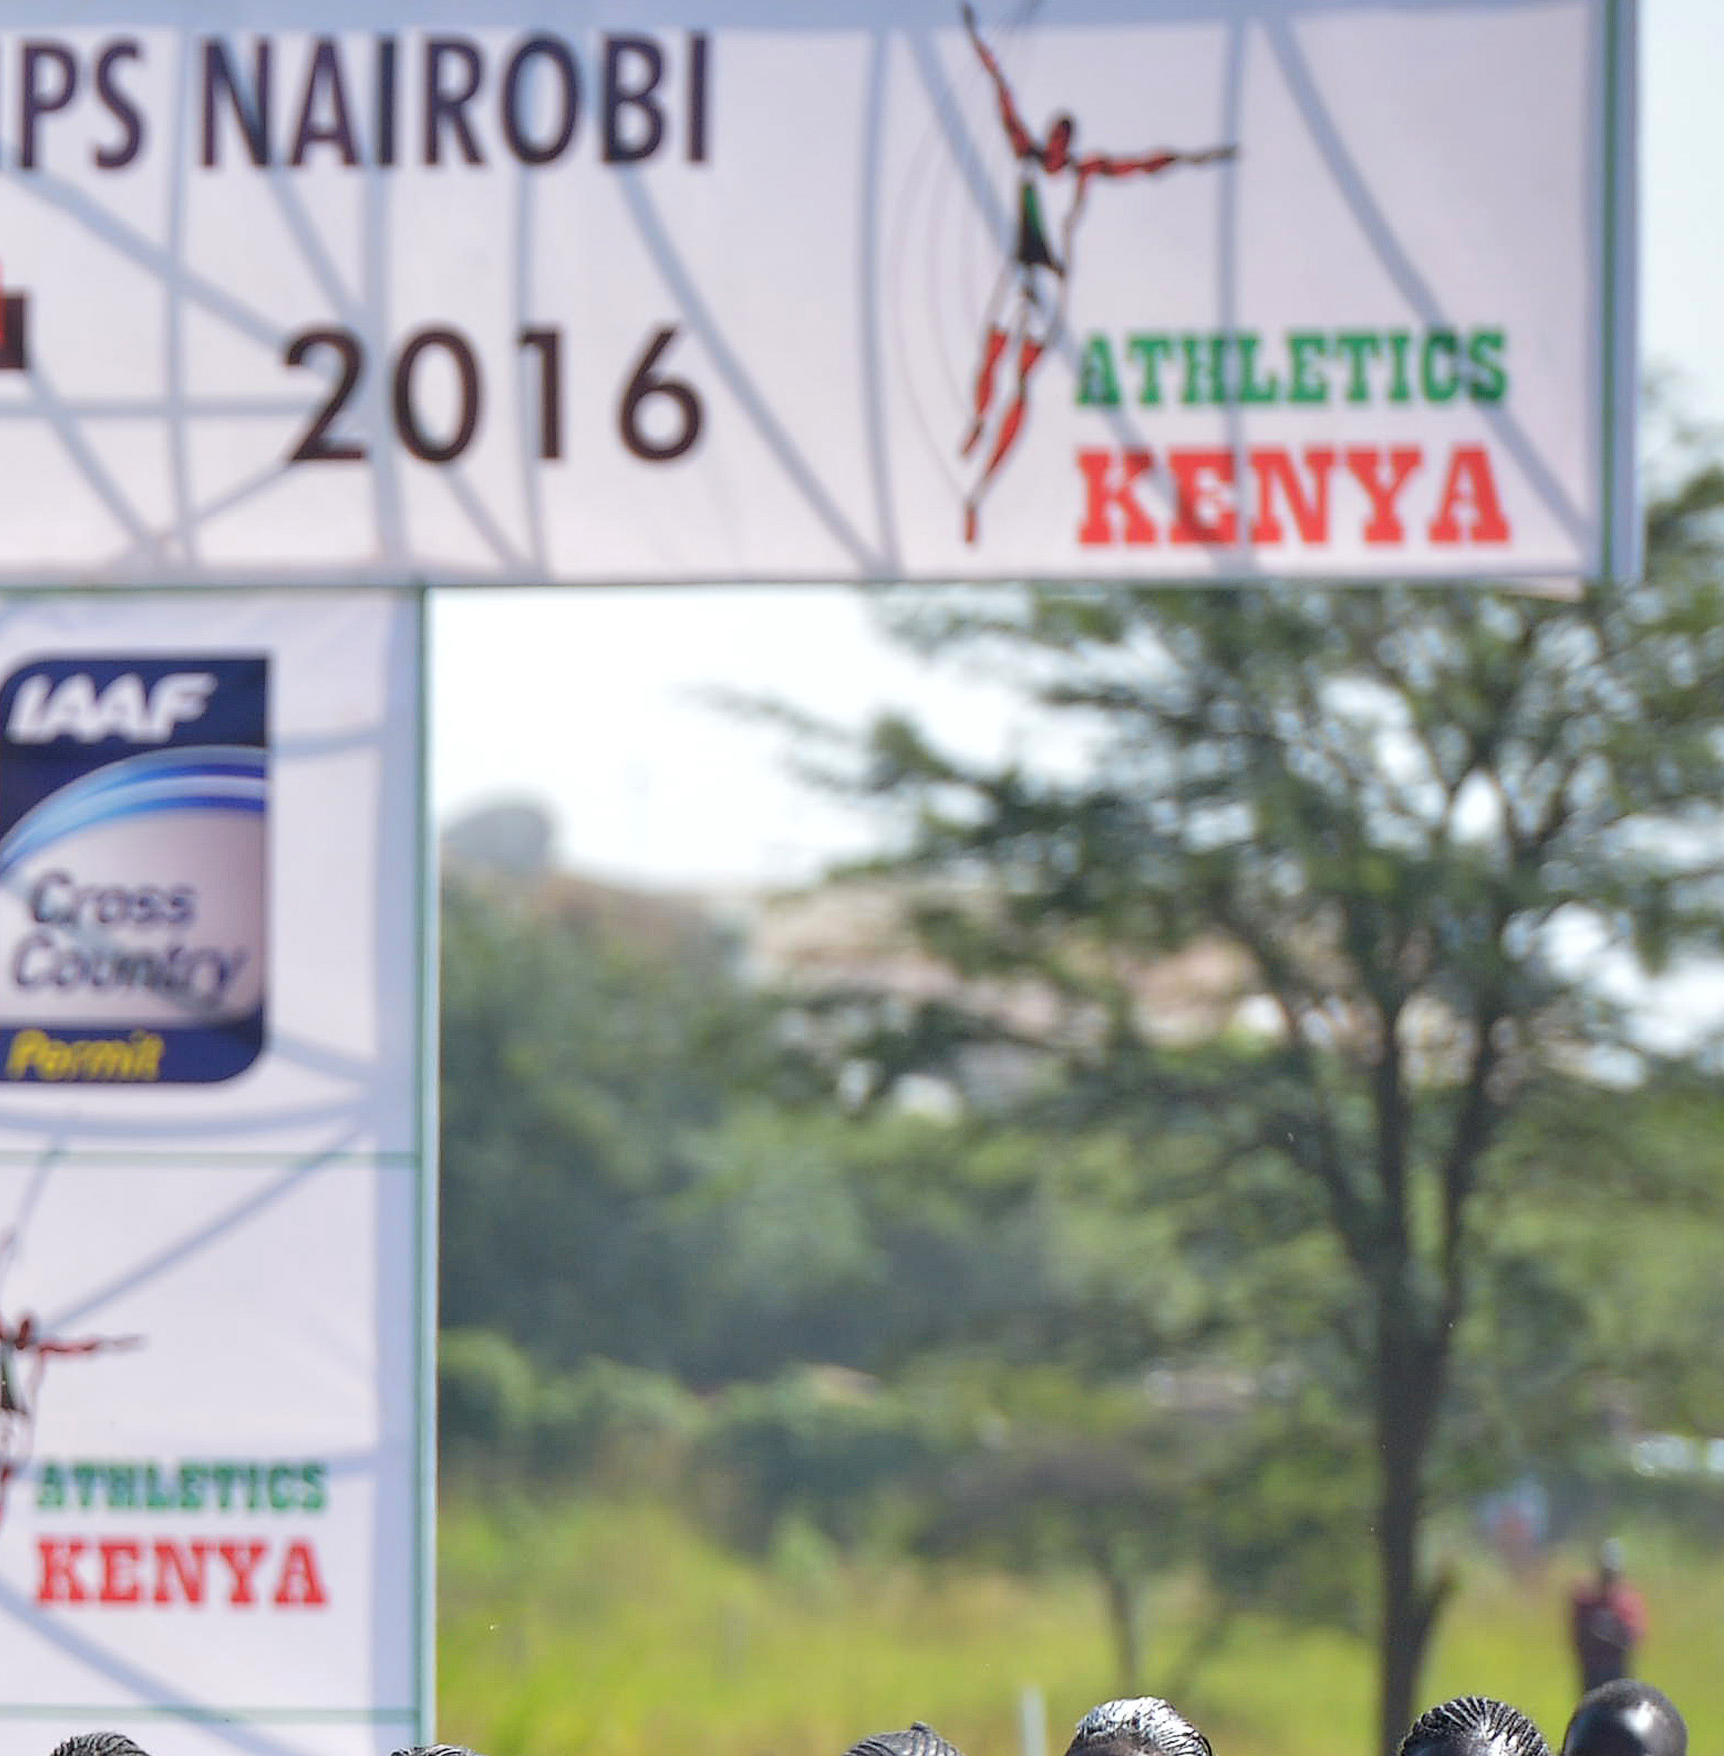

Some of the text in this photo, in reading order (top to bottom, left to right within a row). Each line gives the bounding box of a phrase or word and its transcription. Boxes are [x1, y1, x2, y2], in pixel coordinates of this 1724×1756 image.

[199, 32, 713, 172] NAIROBI
[283, 322, 710, 466] 2016
[1075, 327, 1509, 408] ATHLETICS
[1075, 443, 1510, 548] KENYA
[5, 671, 218, 745] IAAF
[28, 868, 199, 932] Cross
[11, 935, 251, 1014] Country
[5, 1027, 166, 1082] Permit
[34, 1457, 330, 1514] ATHLETICS
[35, 1536, 330, 1612] KENYA
